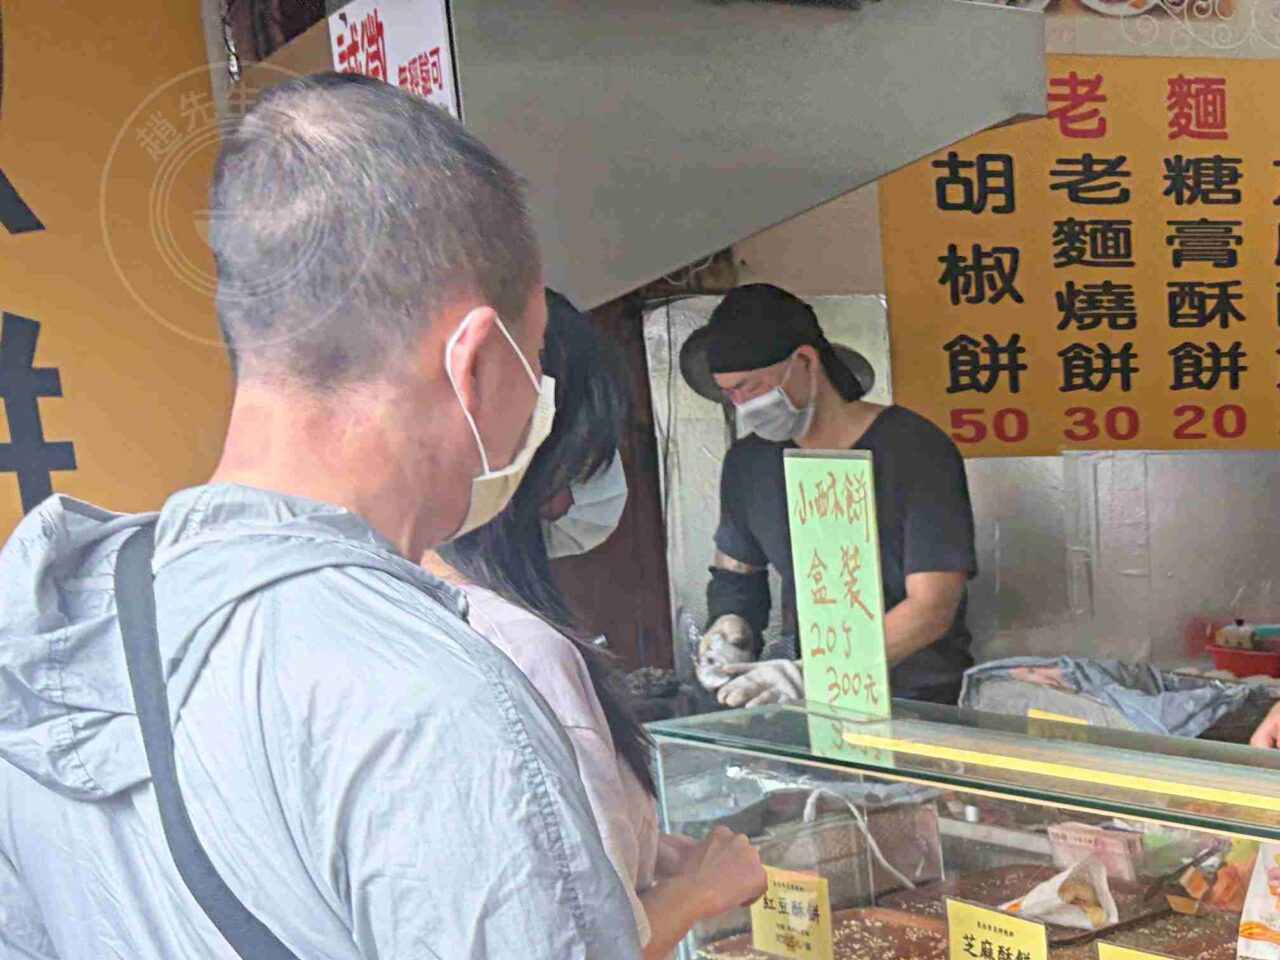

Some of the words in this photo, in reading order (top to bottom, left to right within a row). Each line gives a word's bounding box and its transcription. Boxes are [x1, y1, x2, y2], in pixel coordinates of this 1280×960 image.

[931, 152, 1027, 394] 胡椒餅
[1048, 152, 1140, 393] 老麵燒餅
[1162, 153, 1249, 391] 糖膏酥餅
[949, 407, 1029, 444] 50
[1064, 405, 1140, 442] 30
[1172, 404, 1248, 440] 20
